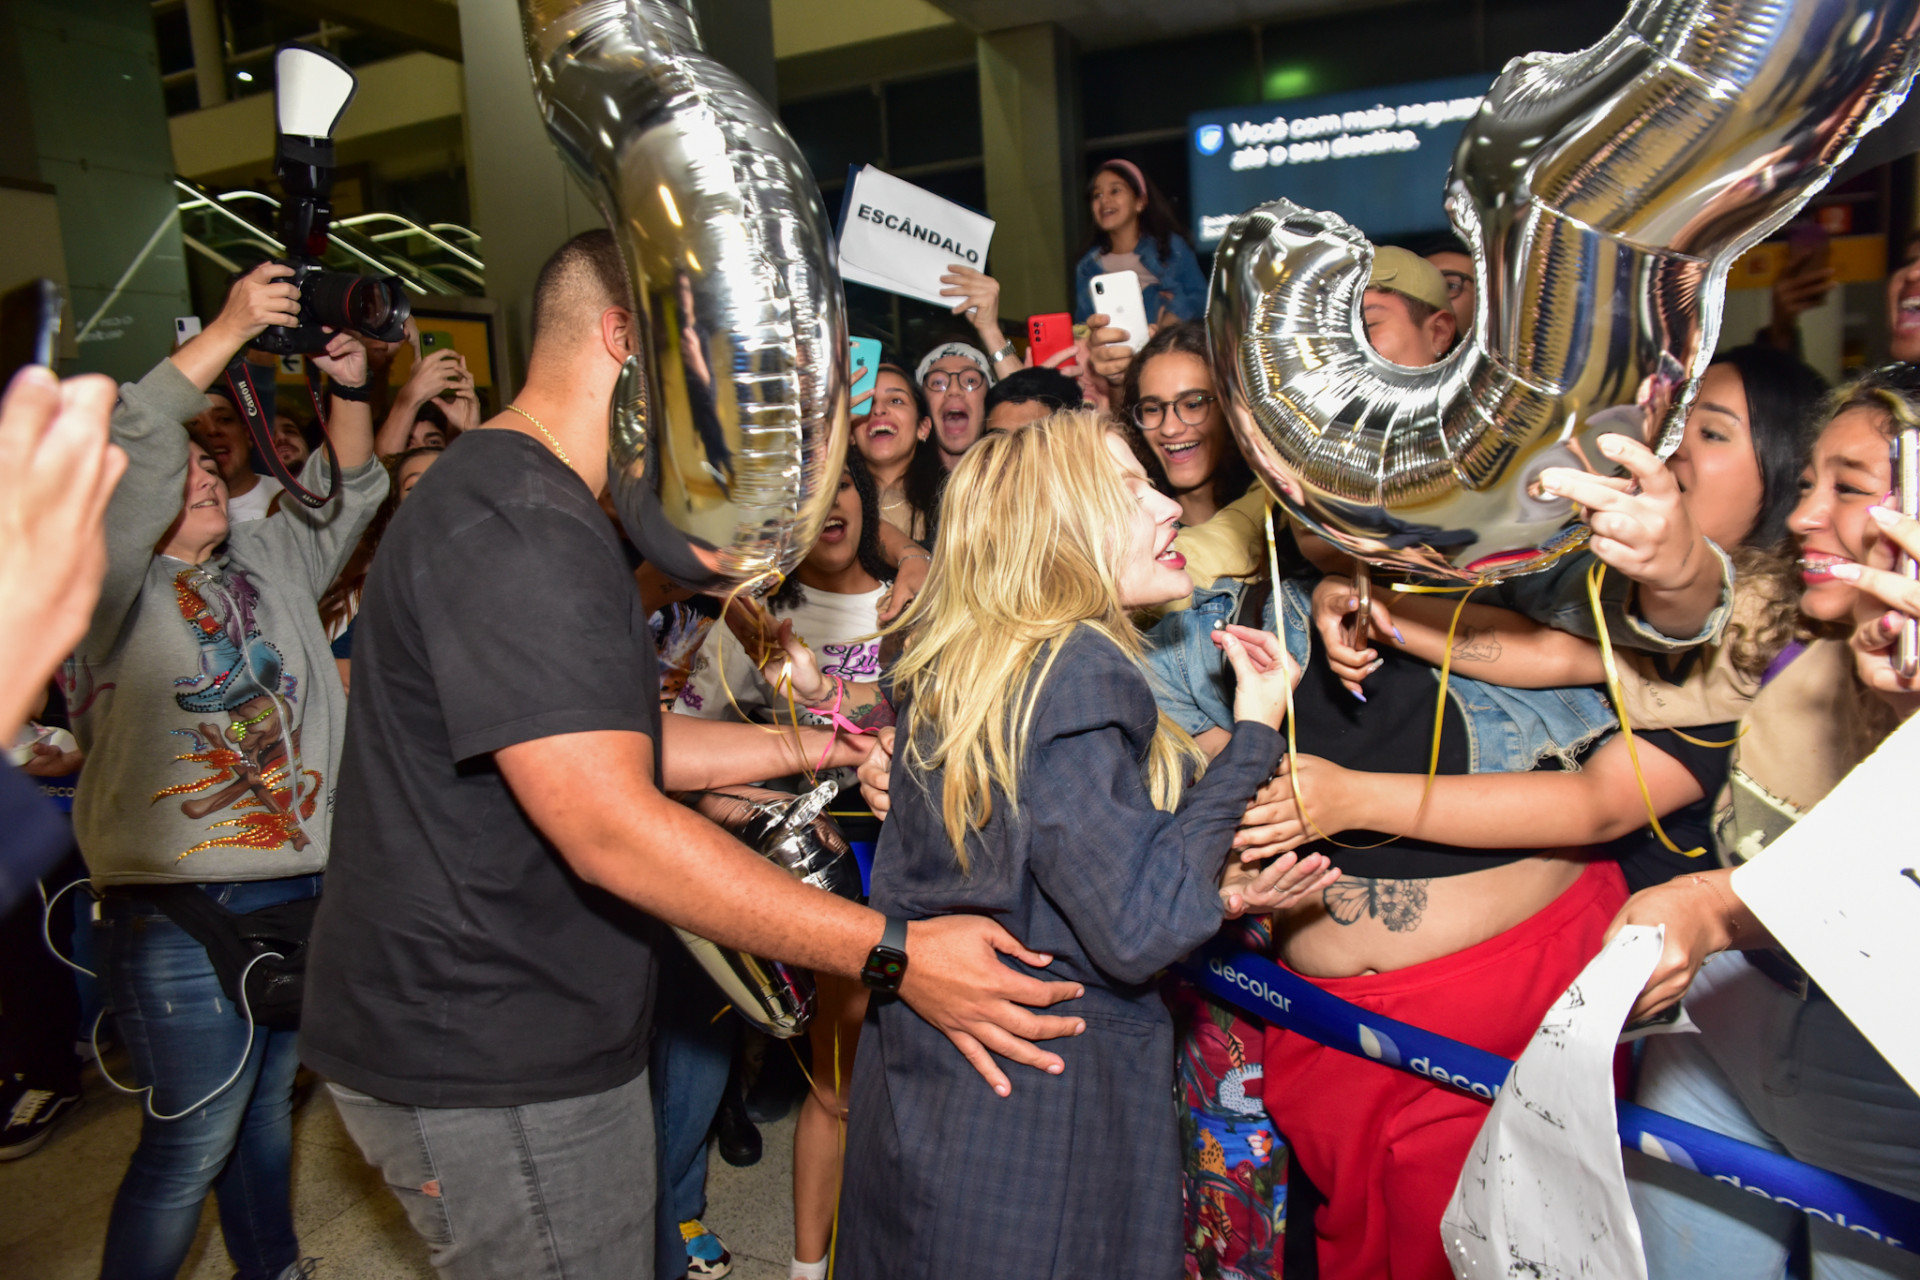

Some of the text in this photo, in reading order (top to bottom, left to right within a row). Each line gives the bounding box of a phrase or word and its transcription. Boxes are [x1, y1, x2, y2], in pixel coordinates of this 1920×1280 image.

[858, 203, 979, 264] ESCÂNDALO
[238, 380, 258, 417] Canon
[1209, 956, 1292, 1013] decolar
